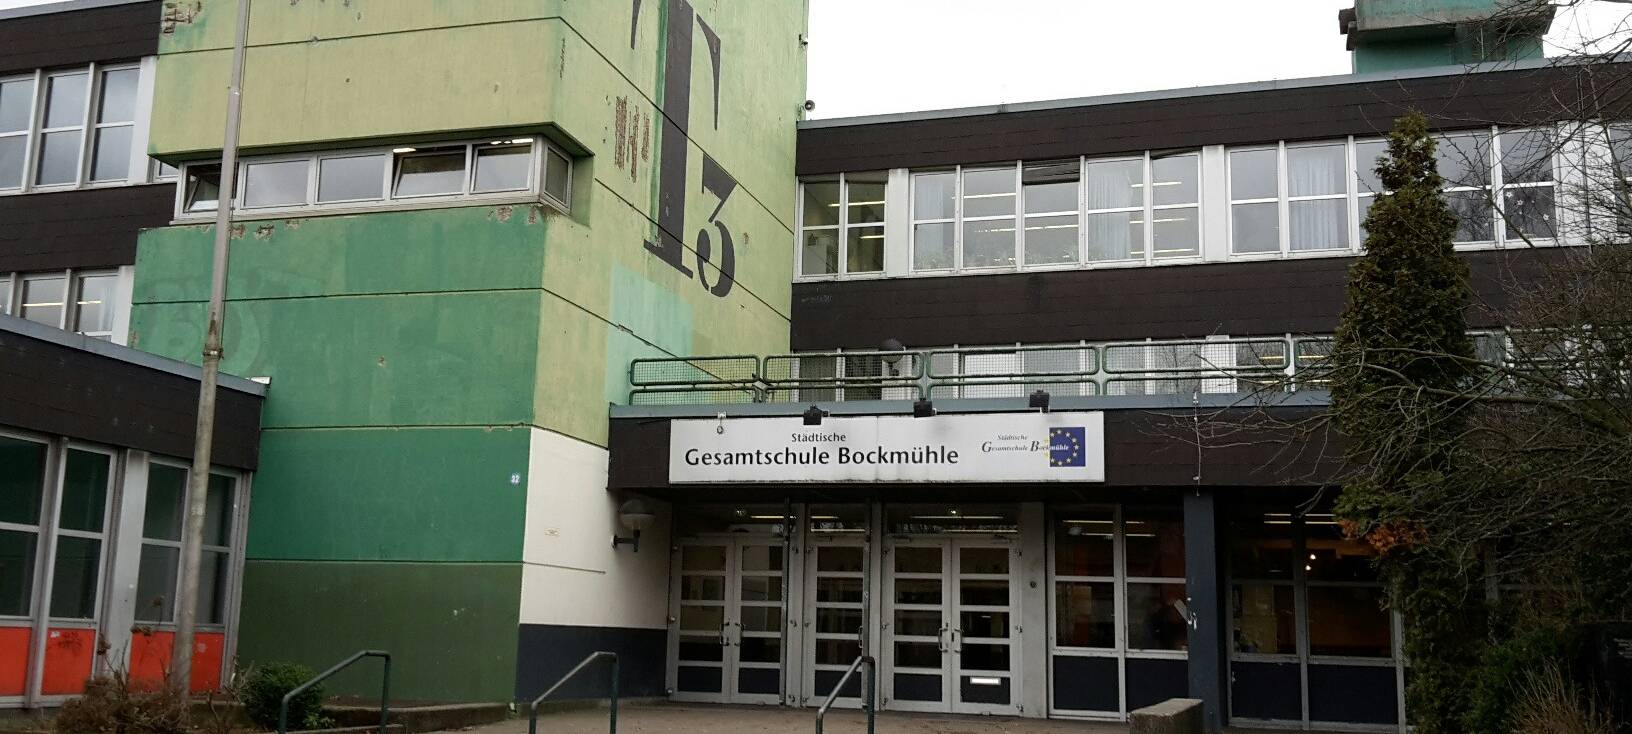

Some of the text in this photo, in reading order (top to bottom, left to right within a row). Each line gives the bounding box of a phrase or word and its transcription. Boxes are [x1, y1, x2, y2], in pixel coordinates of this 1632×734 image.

[791, 432, 847, 443] Städtische
[982, 440, 1069, 452] Gesamtschule Bockmühle
[684, 445, 959, 466] Gesamtschule Bockmühle
